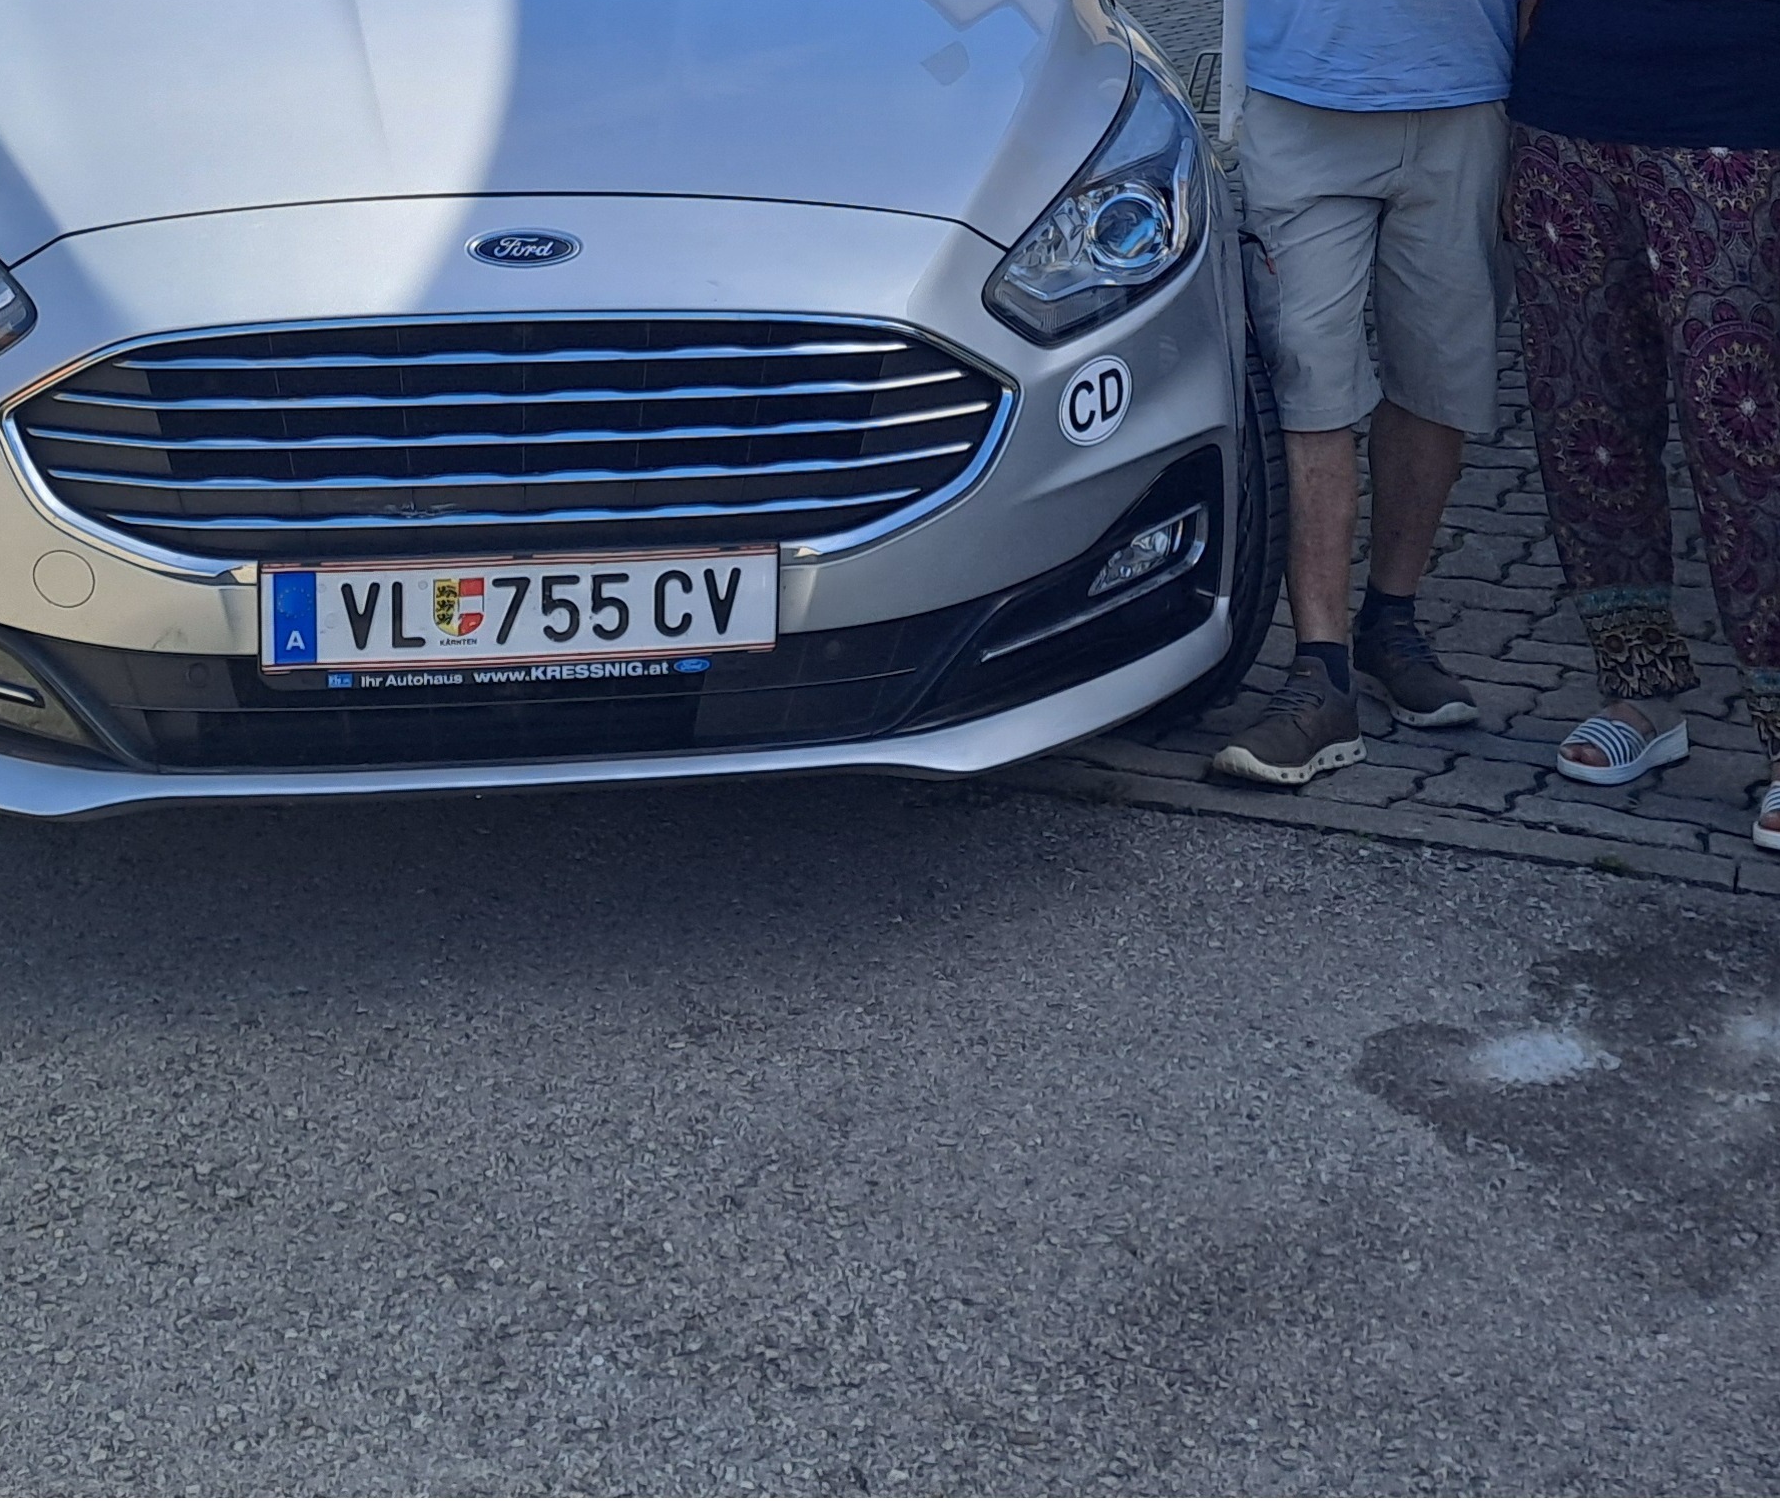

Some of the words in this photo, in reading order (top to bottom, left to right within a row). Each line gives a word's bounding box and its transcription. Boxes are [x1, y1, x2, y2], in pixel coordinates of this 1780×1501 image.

[493, 236, 555, 258] Ford
[1069, 367, 1124, 433] CD
[340, 580, 427, 651] VL
[491, 572, 630, 645] 755
[653, 567, 742, 638] CV
[285, 629, 306, 652] A
[360, 675, 383, 688] Ihr
[385, 673, 464, 688] Autohaus
[473, 661, 669, 684] www.KRESSNIG.at
